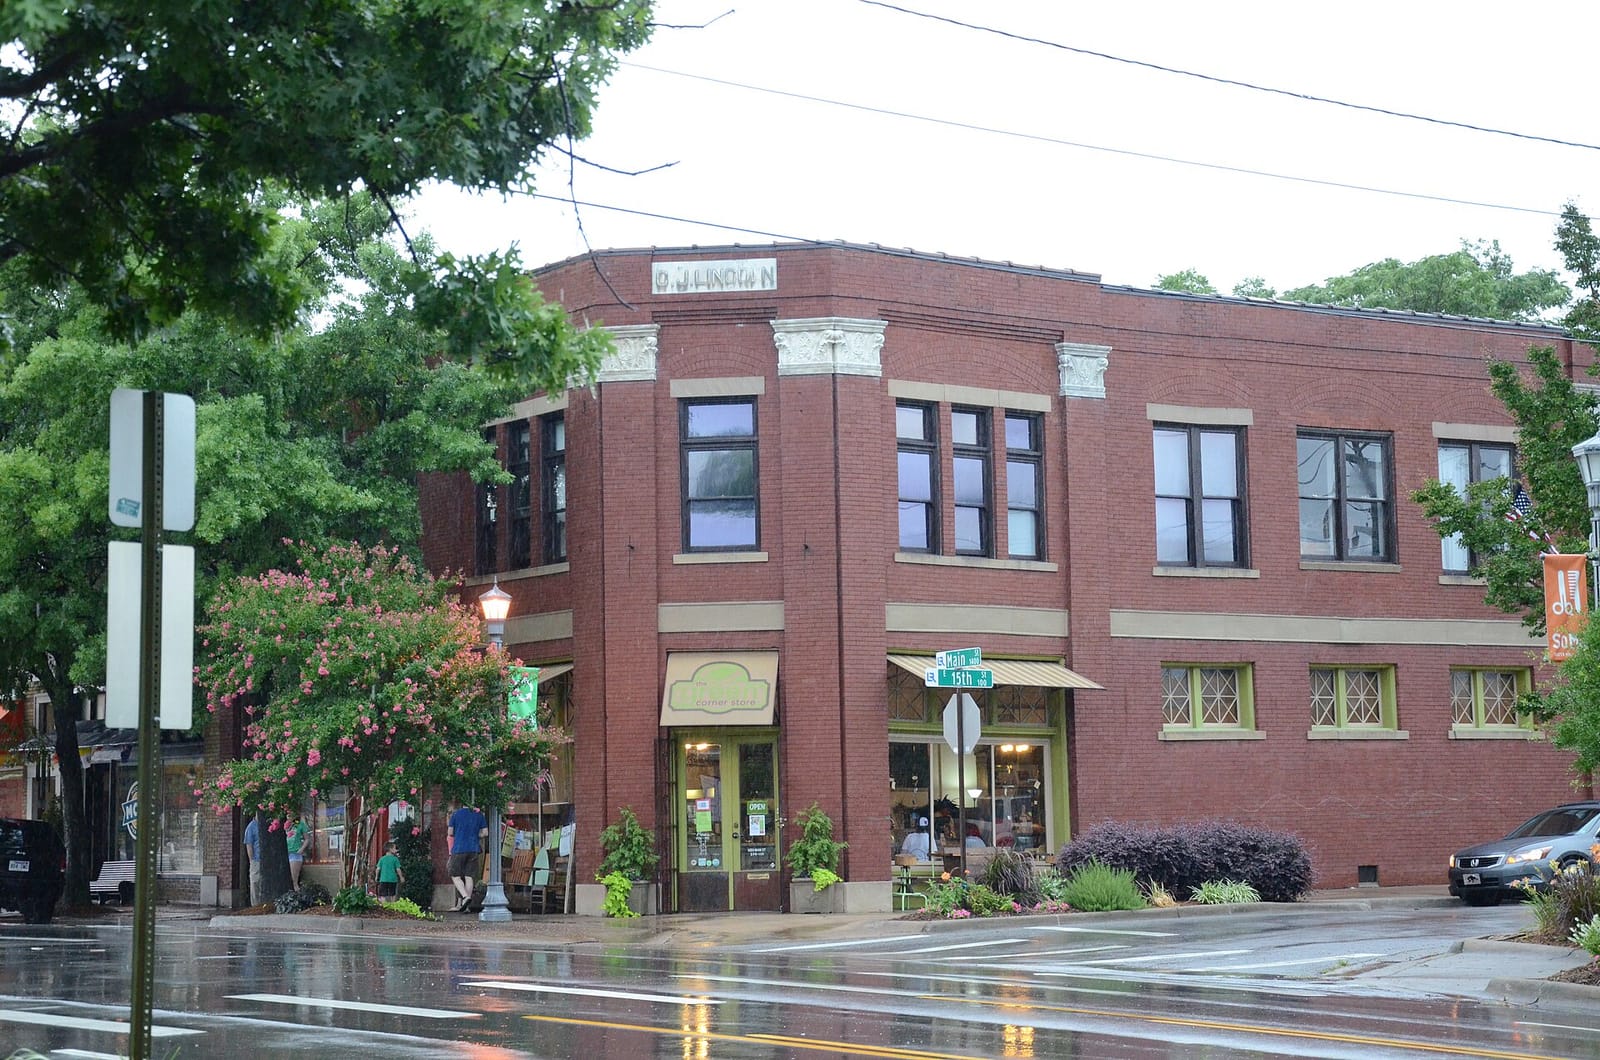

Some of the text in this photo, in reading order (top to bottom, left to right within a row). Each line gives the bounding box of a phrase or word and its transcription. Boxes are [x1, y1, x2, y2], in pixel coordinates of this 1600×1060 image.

[946, 653, 966, 668] Main
[951, 671, 973, 686] 15th
[695, 698, 756, 707] corner store
[749, 803, 766, 811] OPEN
